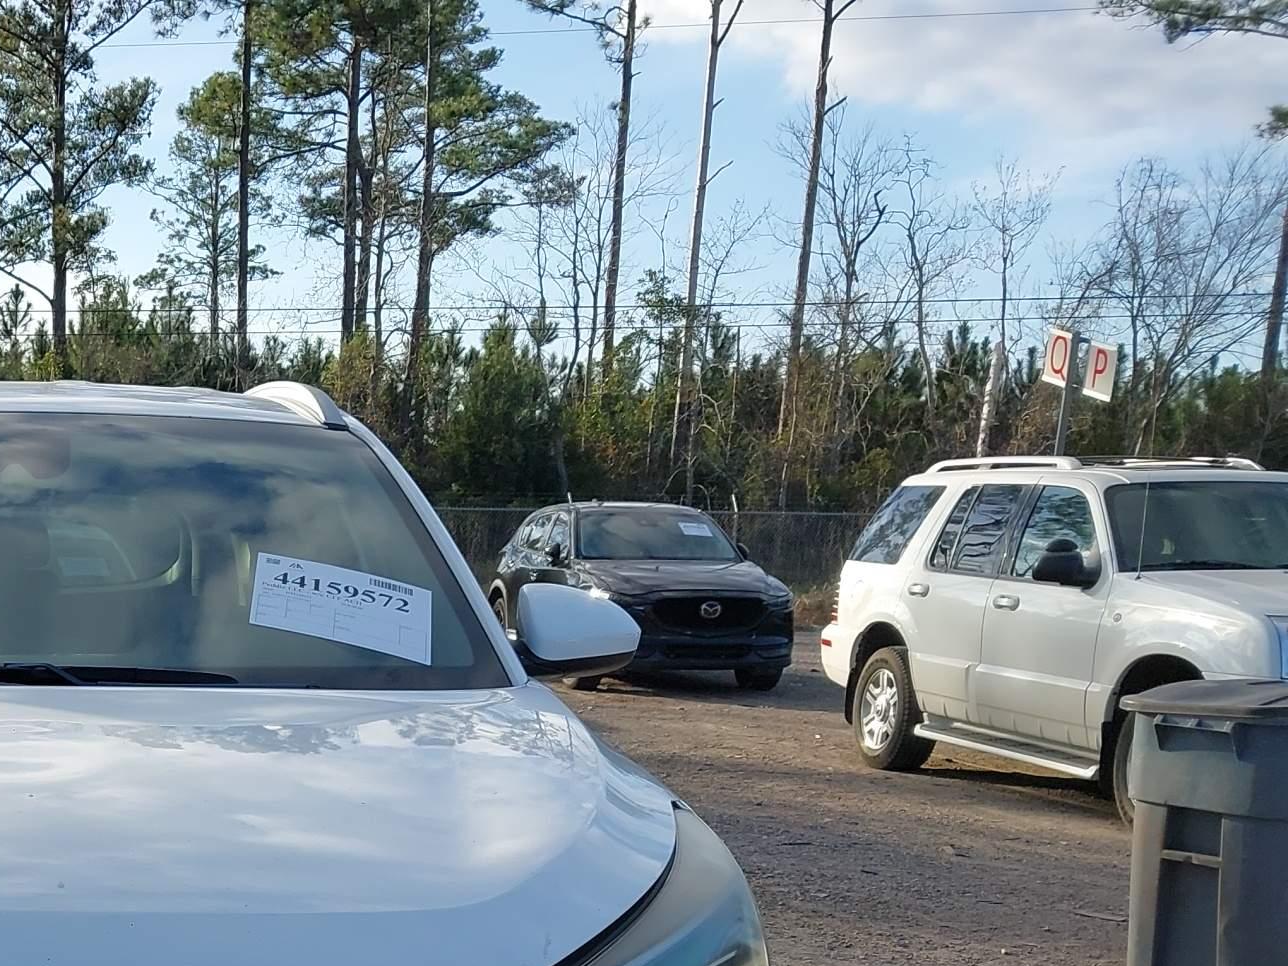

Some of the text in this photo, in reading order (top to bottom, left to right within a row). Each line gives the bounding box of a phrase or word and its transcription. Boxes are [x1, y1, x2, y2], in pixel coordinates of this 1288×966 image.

[1051, 335, 1068, 381] Q
[1092, 348, 1108, 388] P
[273, 572, 410, 613] 44159572
